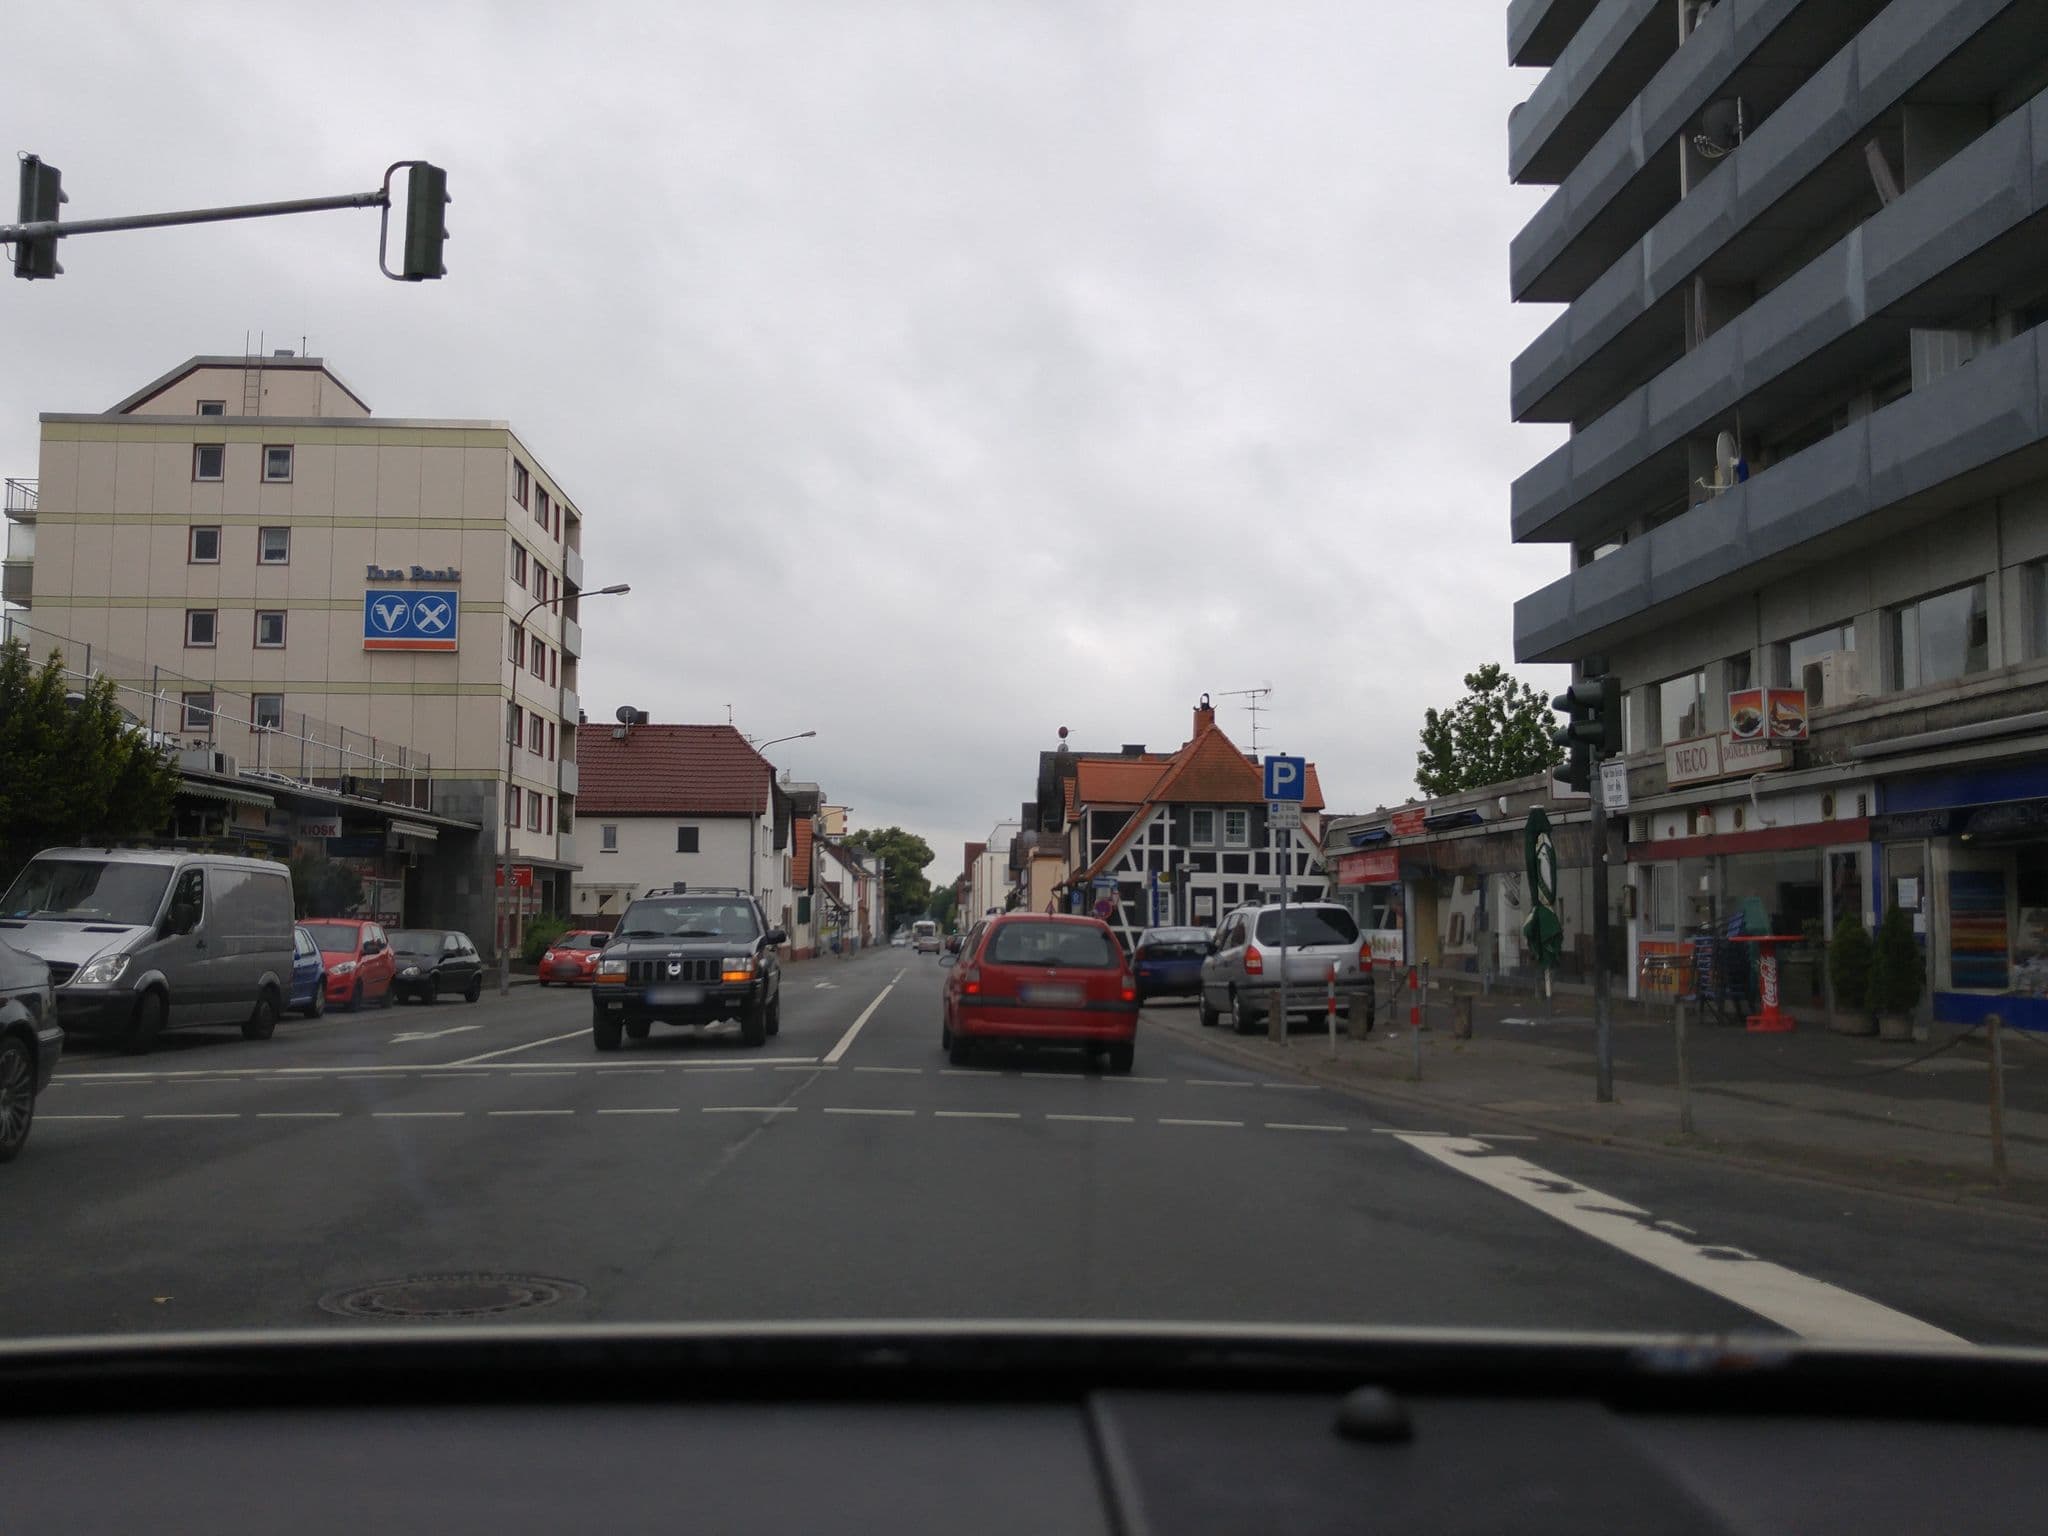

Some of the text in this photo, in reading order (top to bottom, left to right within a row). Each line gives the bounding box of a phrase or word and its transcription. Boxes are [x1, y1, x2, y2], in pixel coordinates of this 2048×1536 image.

[409, 565, 461, 582] Bank
[1675, 746, 1708, 775] NECO
[1273, 761, 1297, 795] P
[301, 824, 337, 836] KIOSK
